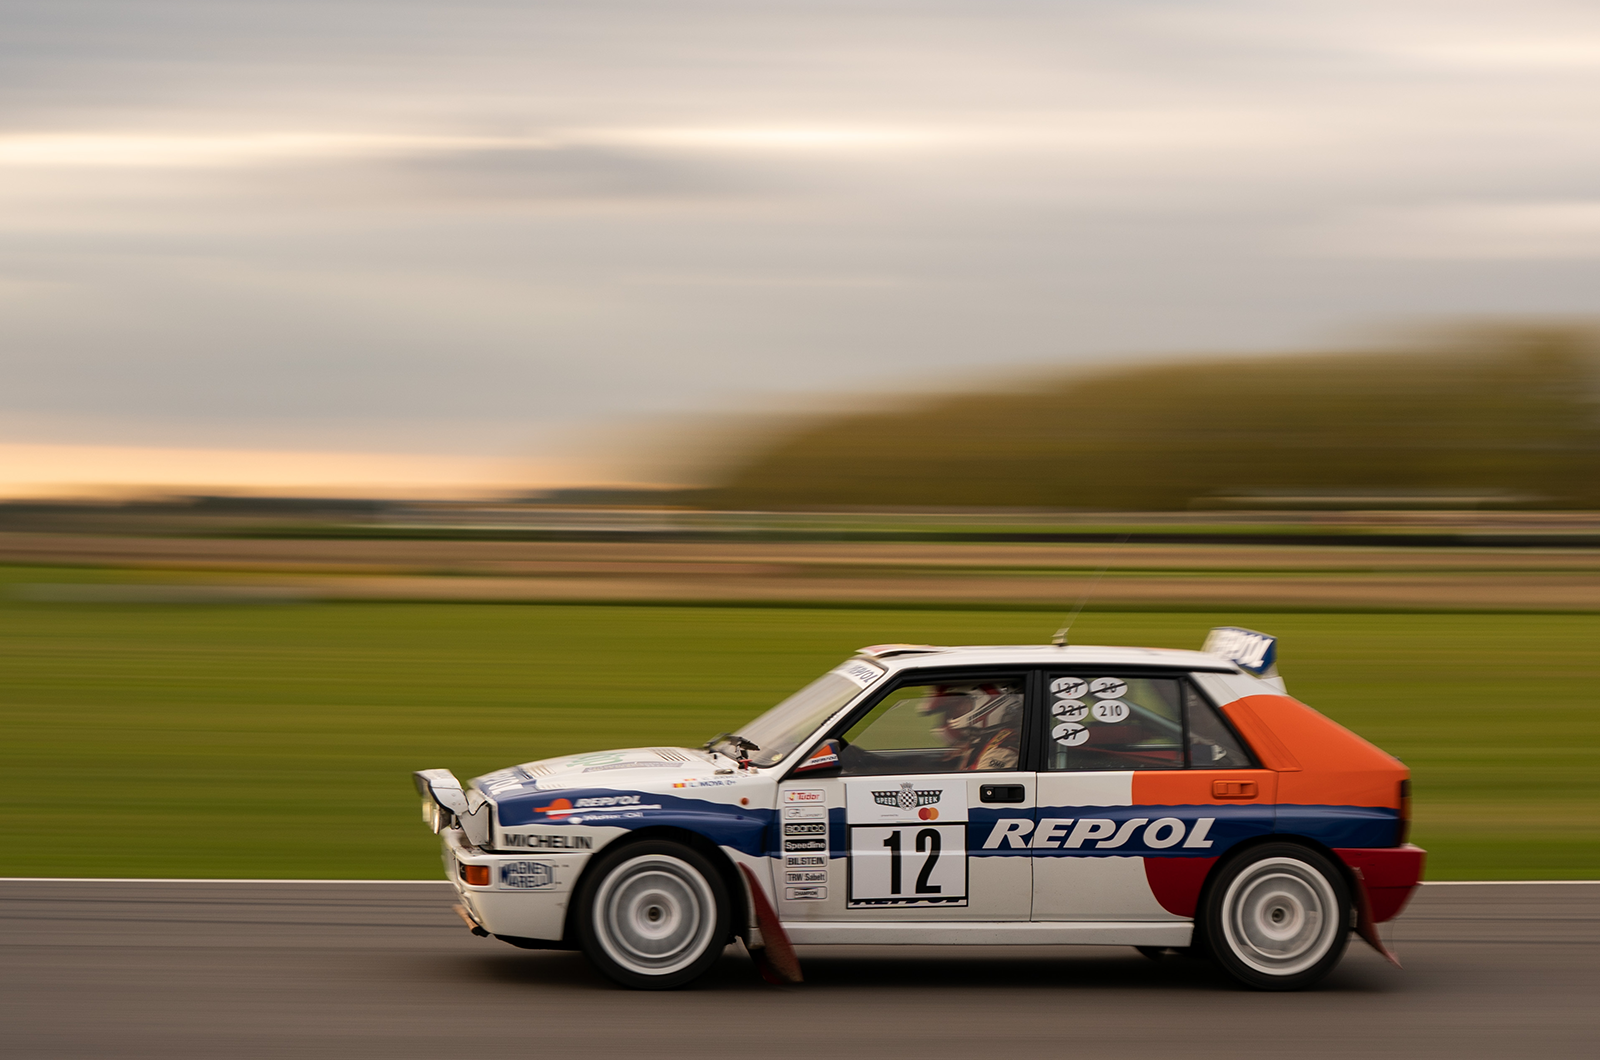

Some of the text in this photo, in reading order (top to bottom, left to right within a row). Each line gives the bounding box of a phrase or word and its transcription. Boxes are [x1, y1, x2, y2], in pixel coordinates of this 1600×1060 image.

[1058, 704, 1083, 716] 221
[1099, 704, 1122, 717] 210
[573, 795, 641, 808] REPSOL
[797, 792, 820, 801] Tudor
[876, 796, 938, 806] SPEED WEEK
[982, 817, 1217, 850] REPSOL
[503, 833, 593, 850] MICHELIN
[785, 841, 826, 851] Speedline
[788, 856, 824, 866] BILSTEIN
[883, 828, 942, 895] 12
[787, 873, 825, 882] TRW Sabelt
